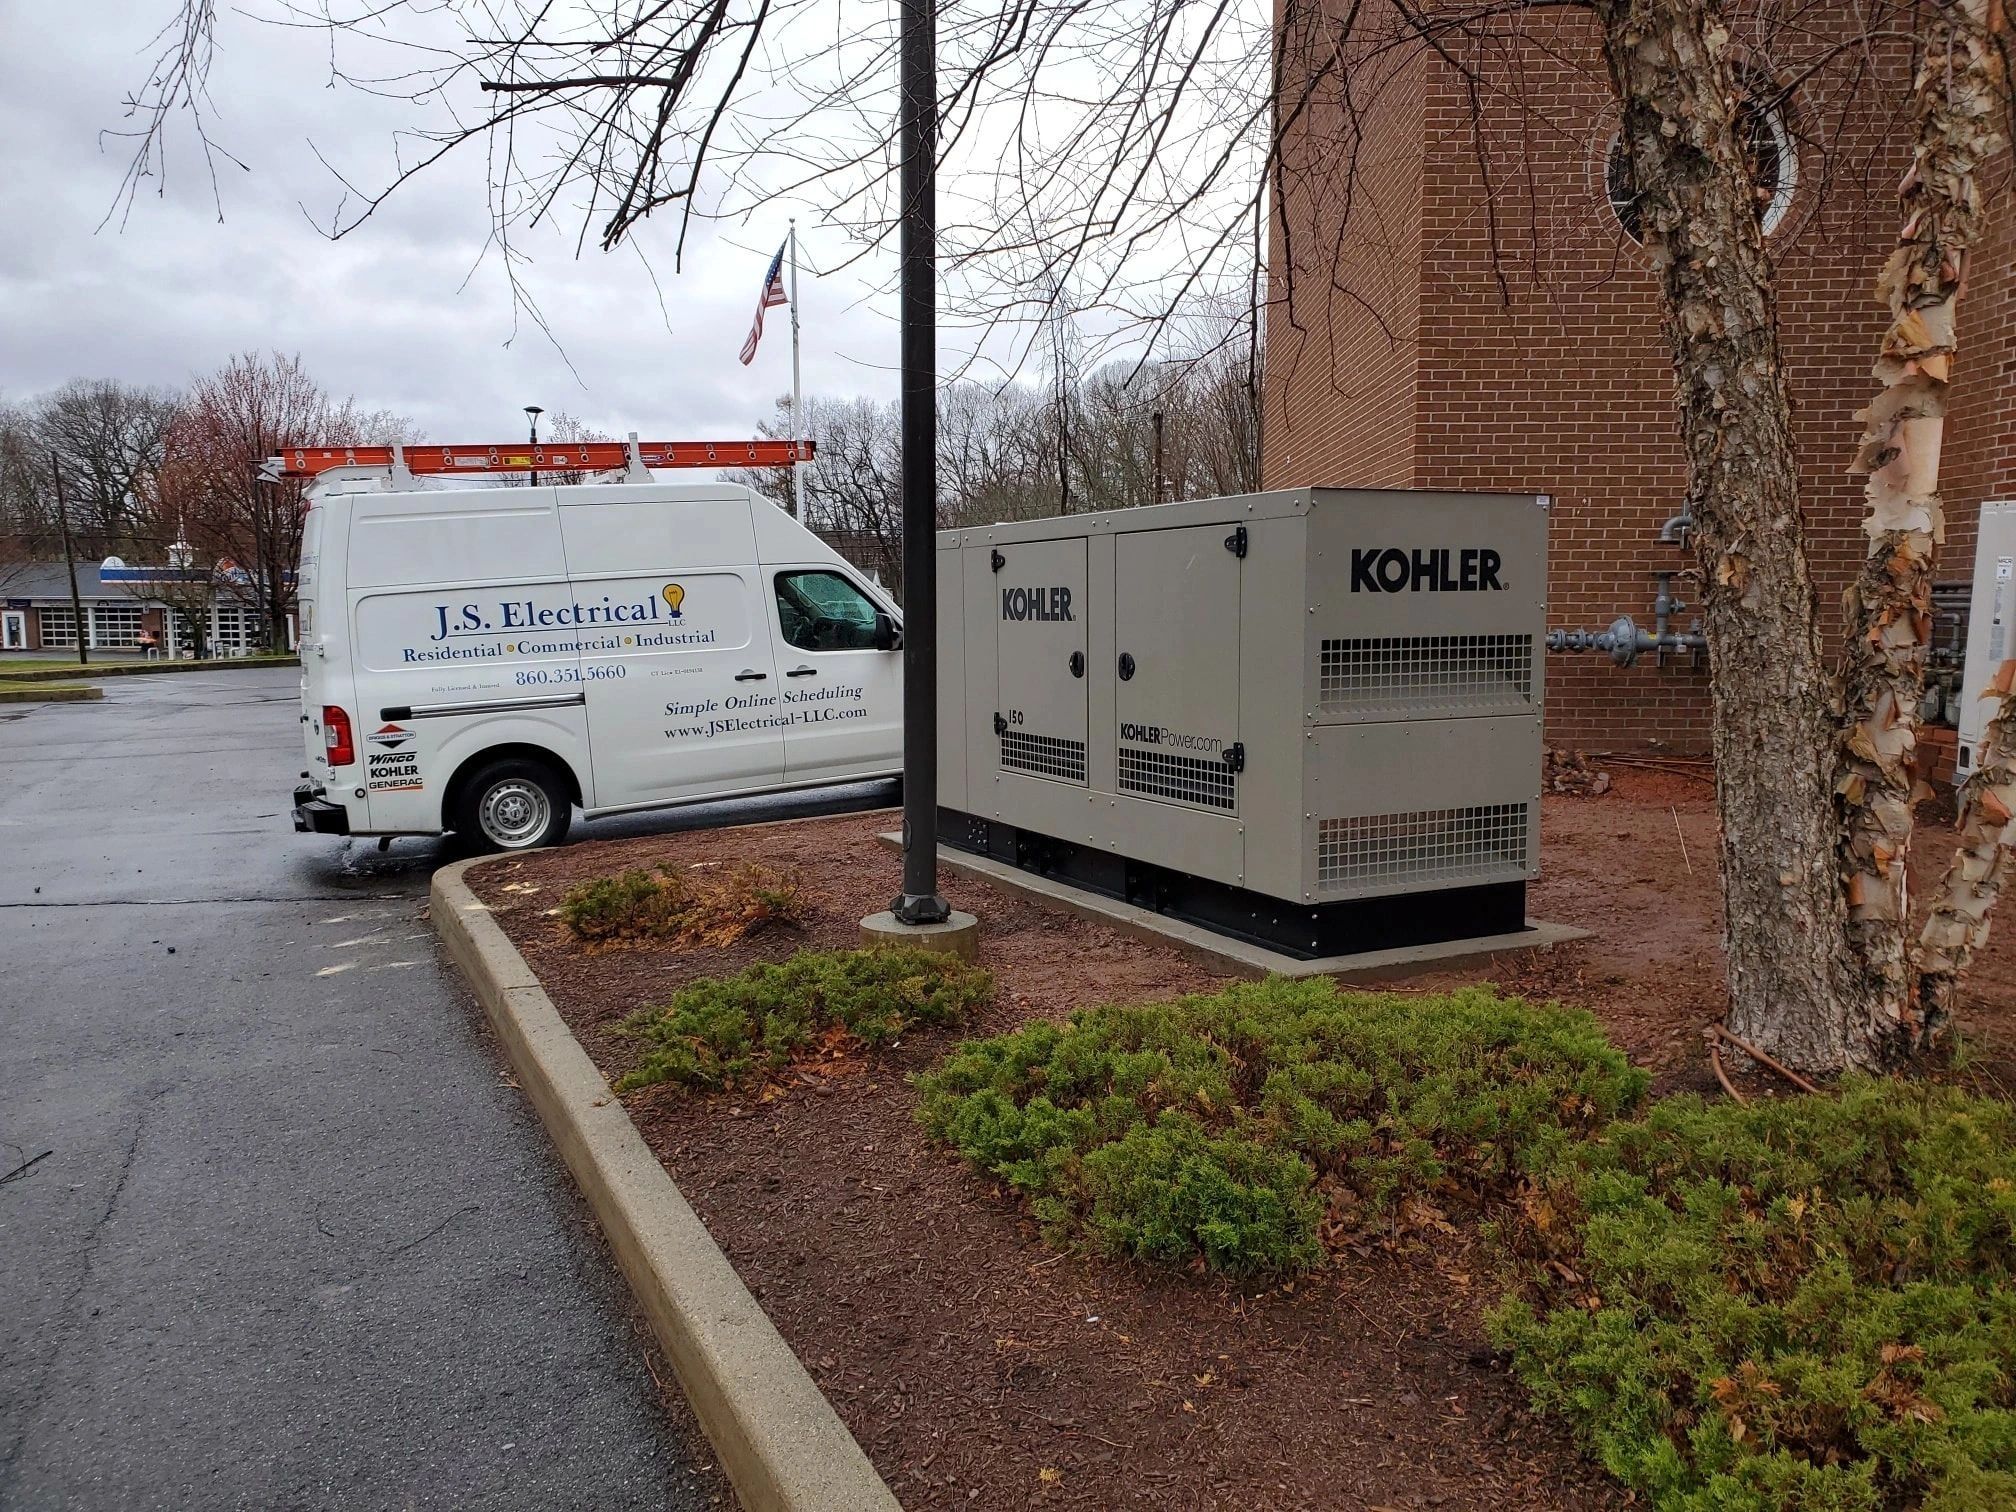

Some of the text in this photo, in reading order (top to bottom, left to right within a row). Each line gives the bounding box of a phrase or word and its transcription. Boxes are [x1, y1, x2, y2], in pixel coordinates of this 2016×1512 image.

[1351, 548, 1502, 593] KOHLER
[431, 596, 659, 641] J.S. Electrical
[1002, 587, 1073, 621] KOHLER
[668, 618, 686, 627] LLC
[402, 630, 715, 663] Residential Commercial Industrial
[516, 664, 626, 686] 860.351.5660
[664, 685, 863, 718] Simple Online Scheduling
[664, 707, 867, 739] www.JSElectrical-LLC.com
[1009, 709, 1024, 725] 150
[1120, 723, 1222, 752] KOHLERPower.com
[369, 778, 423, 789] GENERAC
[370, 765, 419, 778] KOHLER
